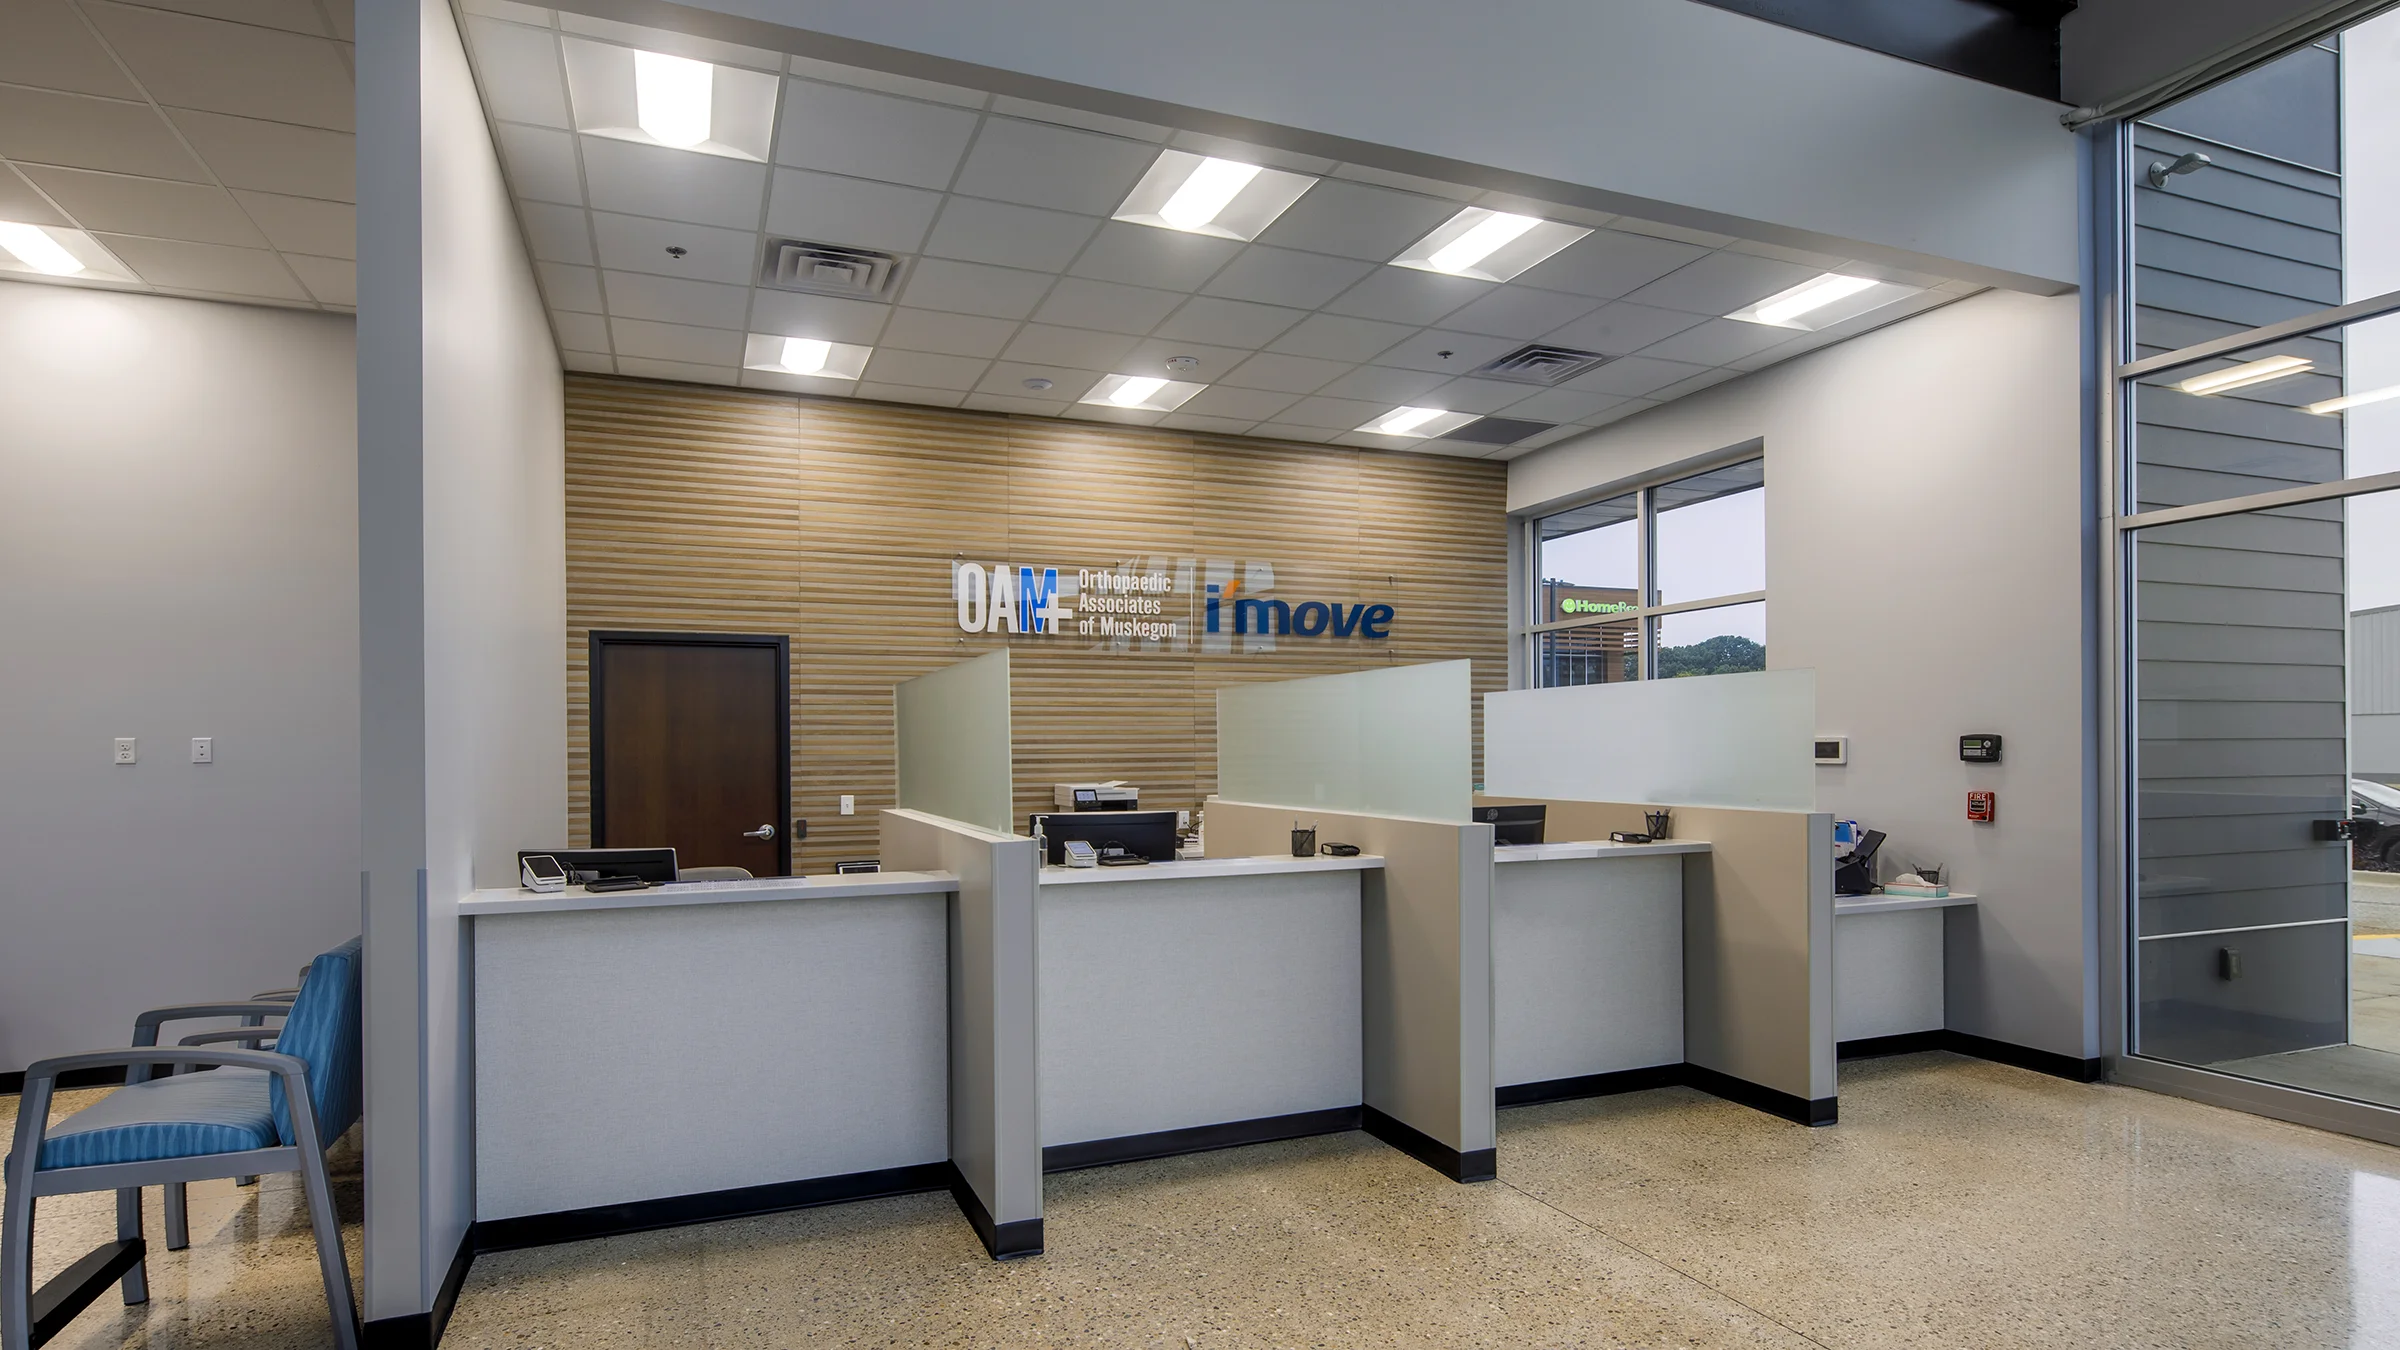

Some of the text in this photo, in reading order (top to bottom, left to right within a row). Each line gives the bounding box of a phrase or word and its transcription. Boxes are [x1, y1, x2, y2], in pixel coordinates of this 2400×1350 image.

[1079, 568, 1172, 593] Orthopaedic
[1078, 592, 1162, 615] Associates
[1079, 616, 1177, 641] of Muskegon
[1969, 792, 1987, 800] FIRE
